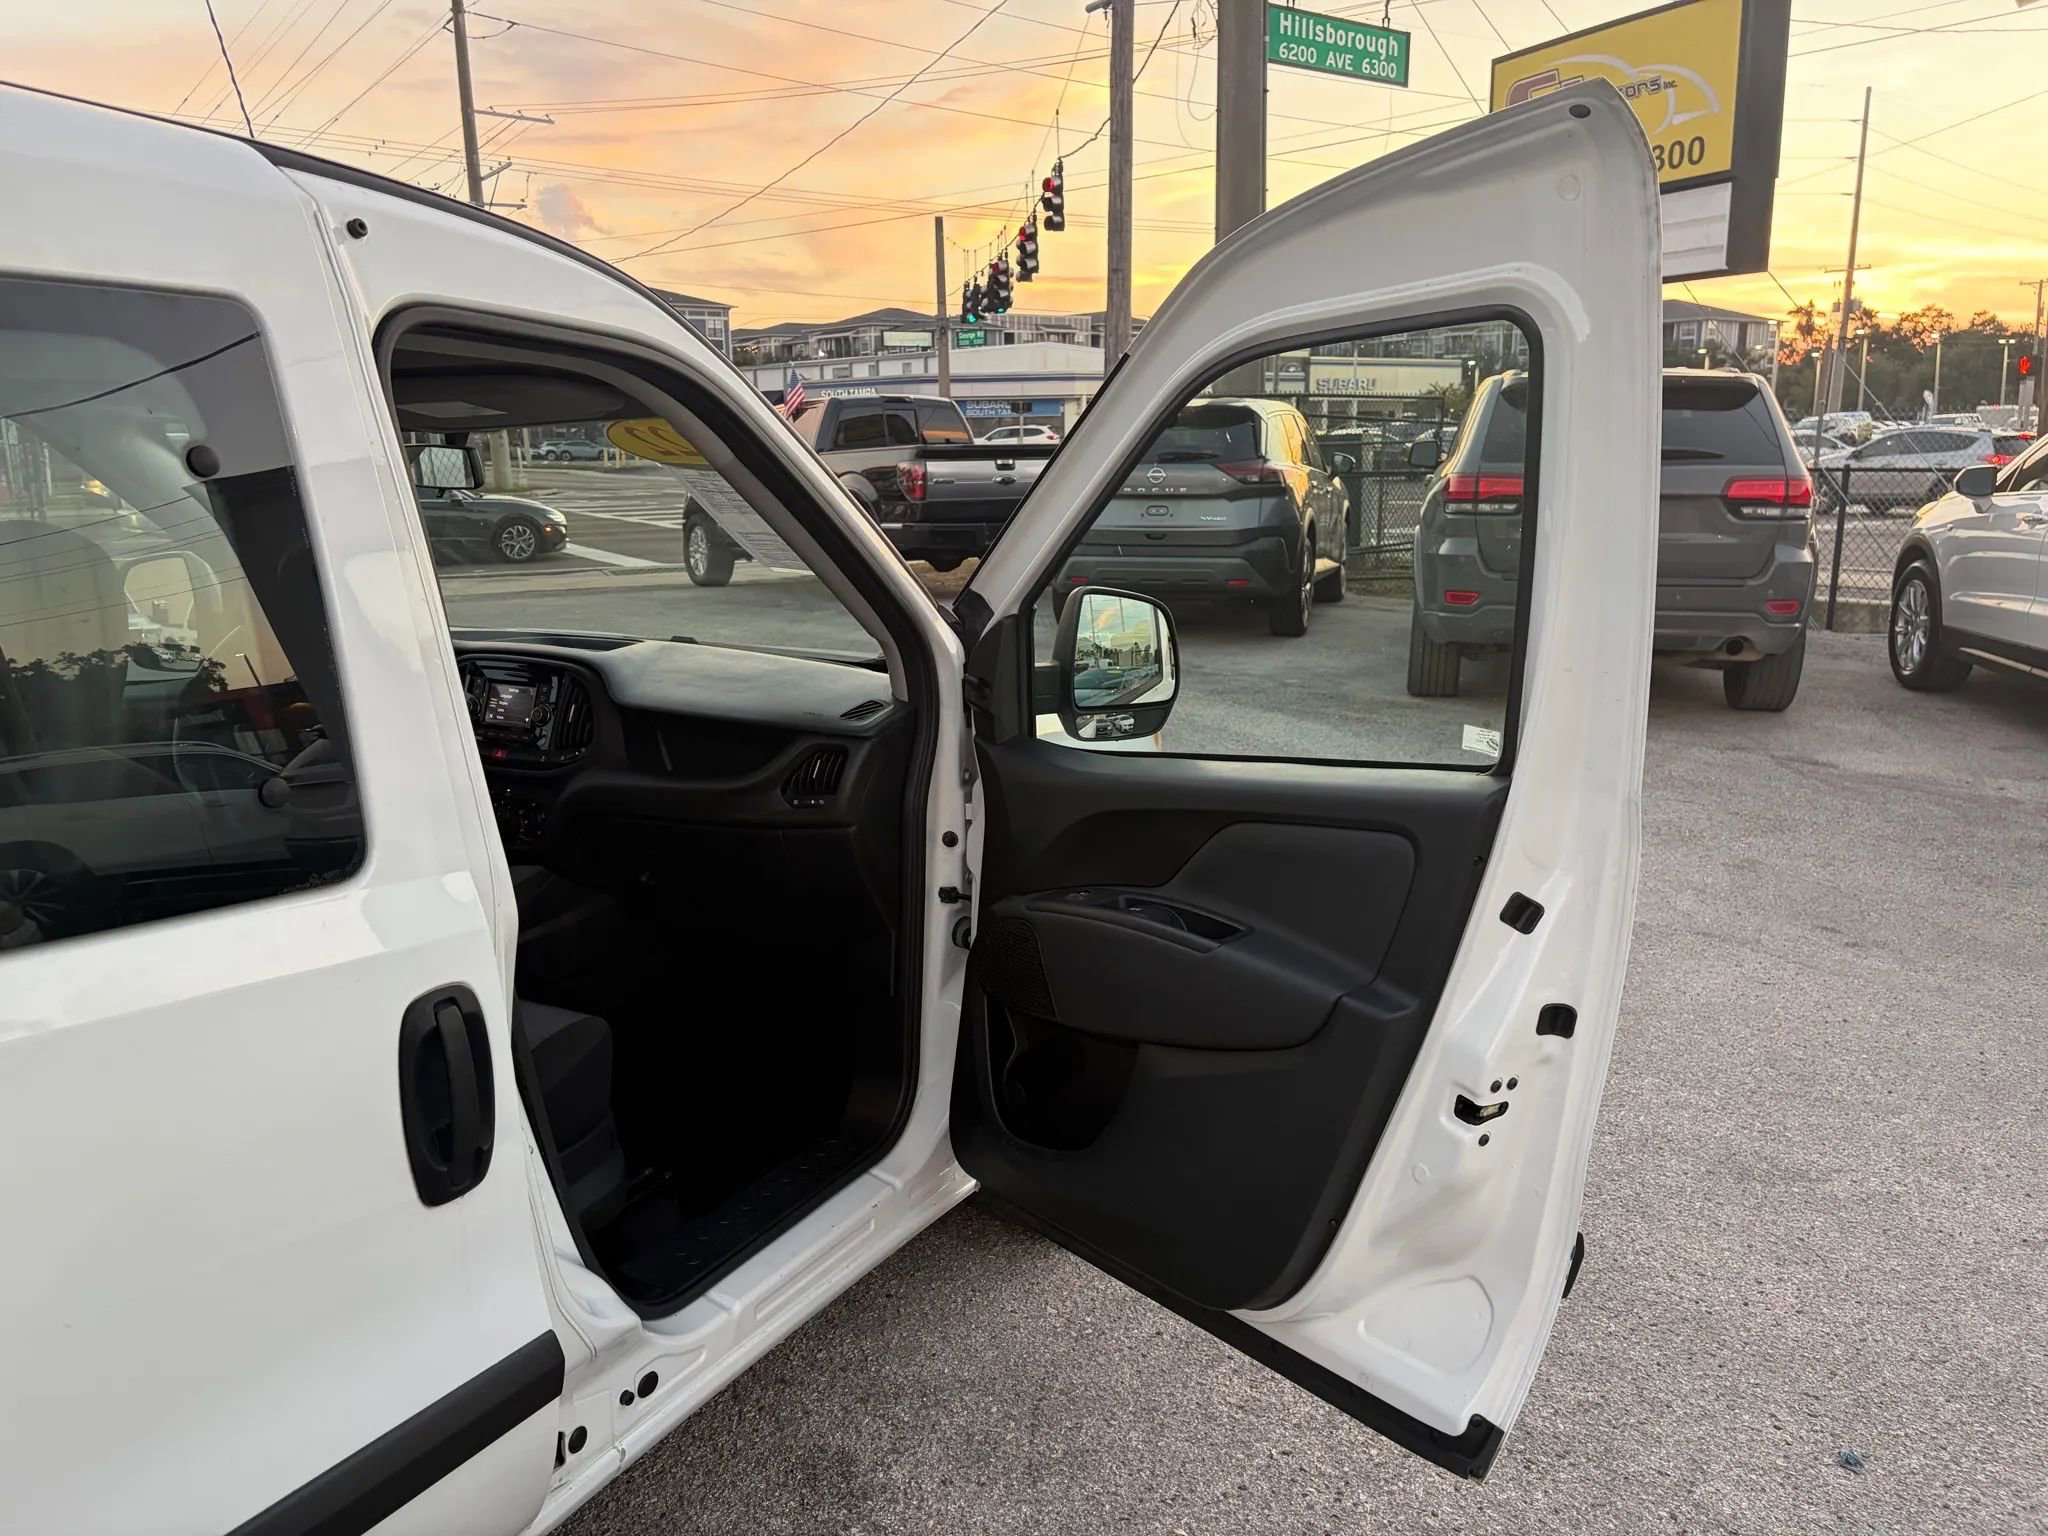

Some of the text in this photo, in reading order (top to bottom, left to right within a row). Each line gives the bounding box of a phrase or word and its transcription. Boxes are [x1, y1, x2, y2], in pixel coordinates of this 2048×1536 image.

[1279, 12, 1399, 61] Hillsborough
[1278, 42, 1398, 79] 6200 AVE 6300
[1315, 377, 1377, 392] SUBARU
[820, 389, 849, 398] SOUTH
[965, 409, 996, 417] SOUTH
